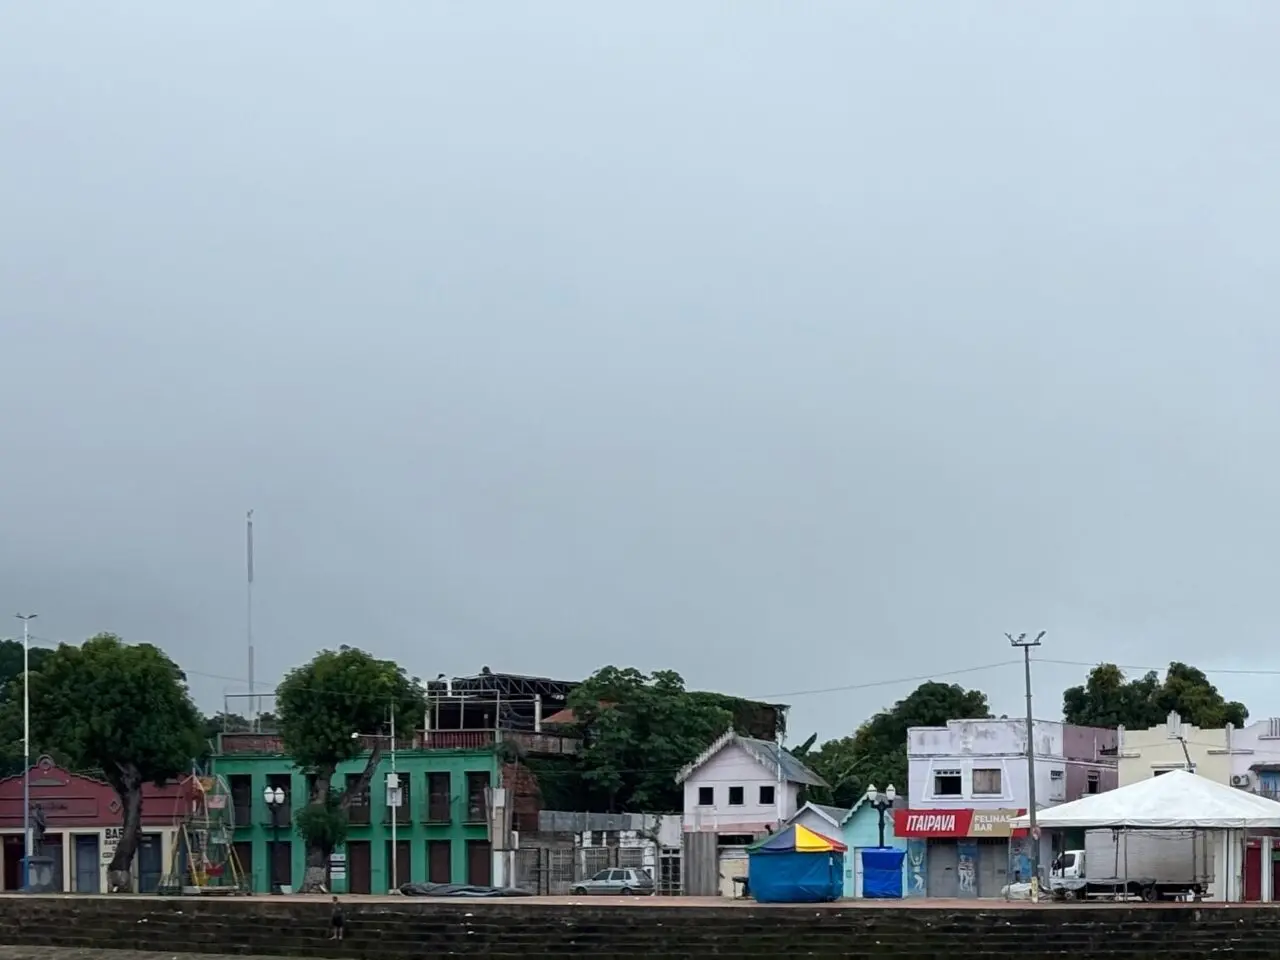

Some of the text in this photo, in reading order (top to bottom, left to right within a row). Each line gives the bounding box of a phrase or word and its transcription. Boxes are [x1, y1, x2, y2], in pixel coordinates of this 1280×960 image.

[906, 815, 955, 831] ITAIPAVA
[974, 815, 1011, 823] FELINAS
[974, 823, 992, 831] BAR
